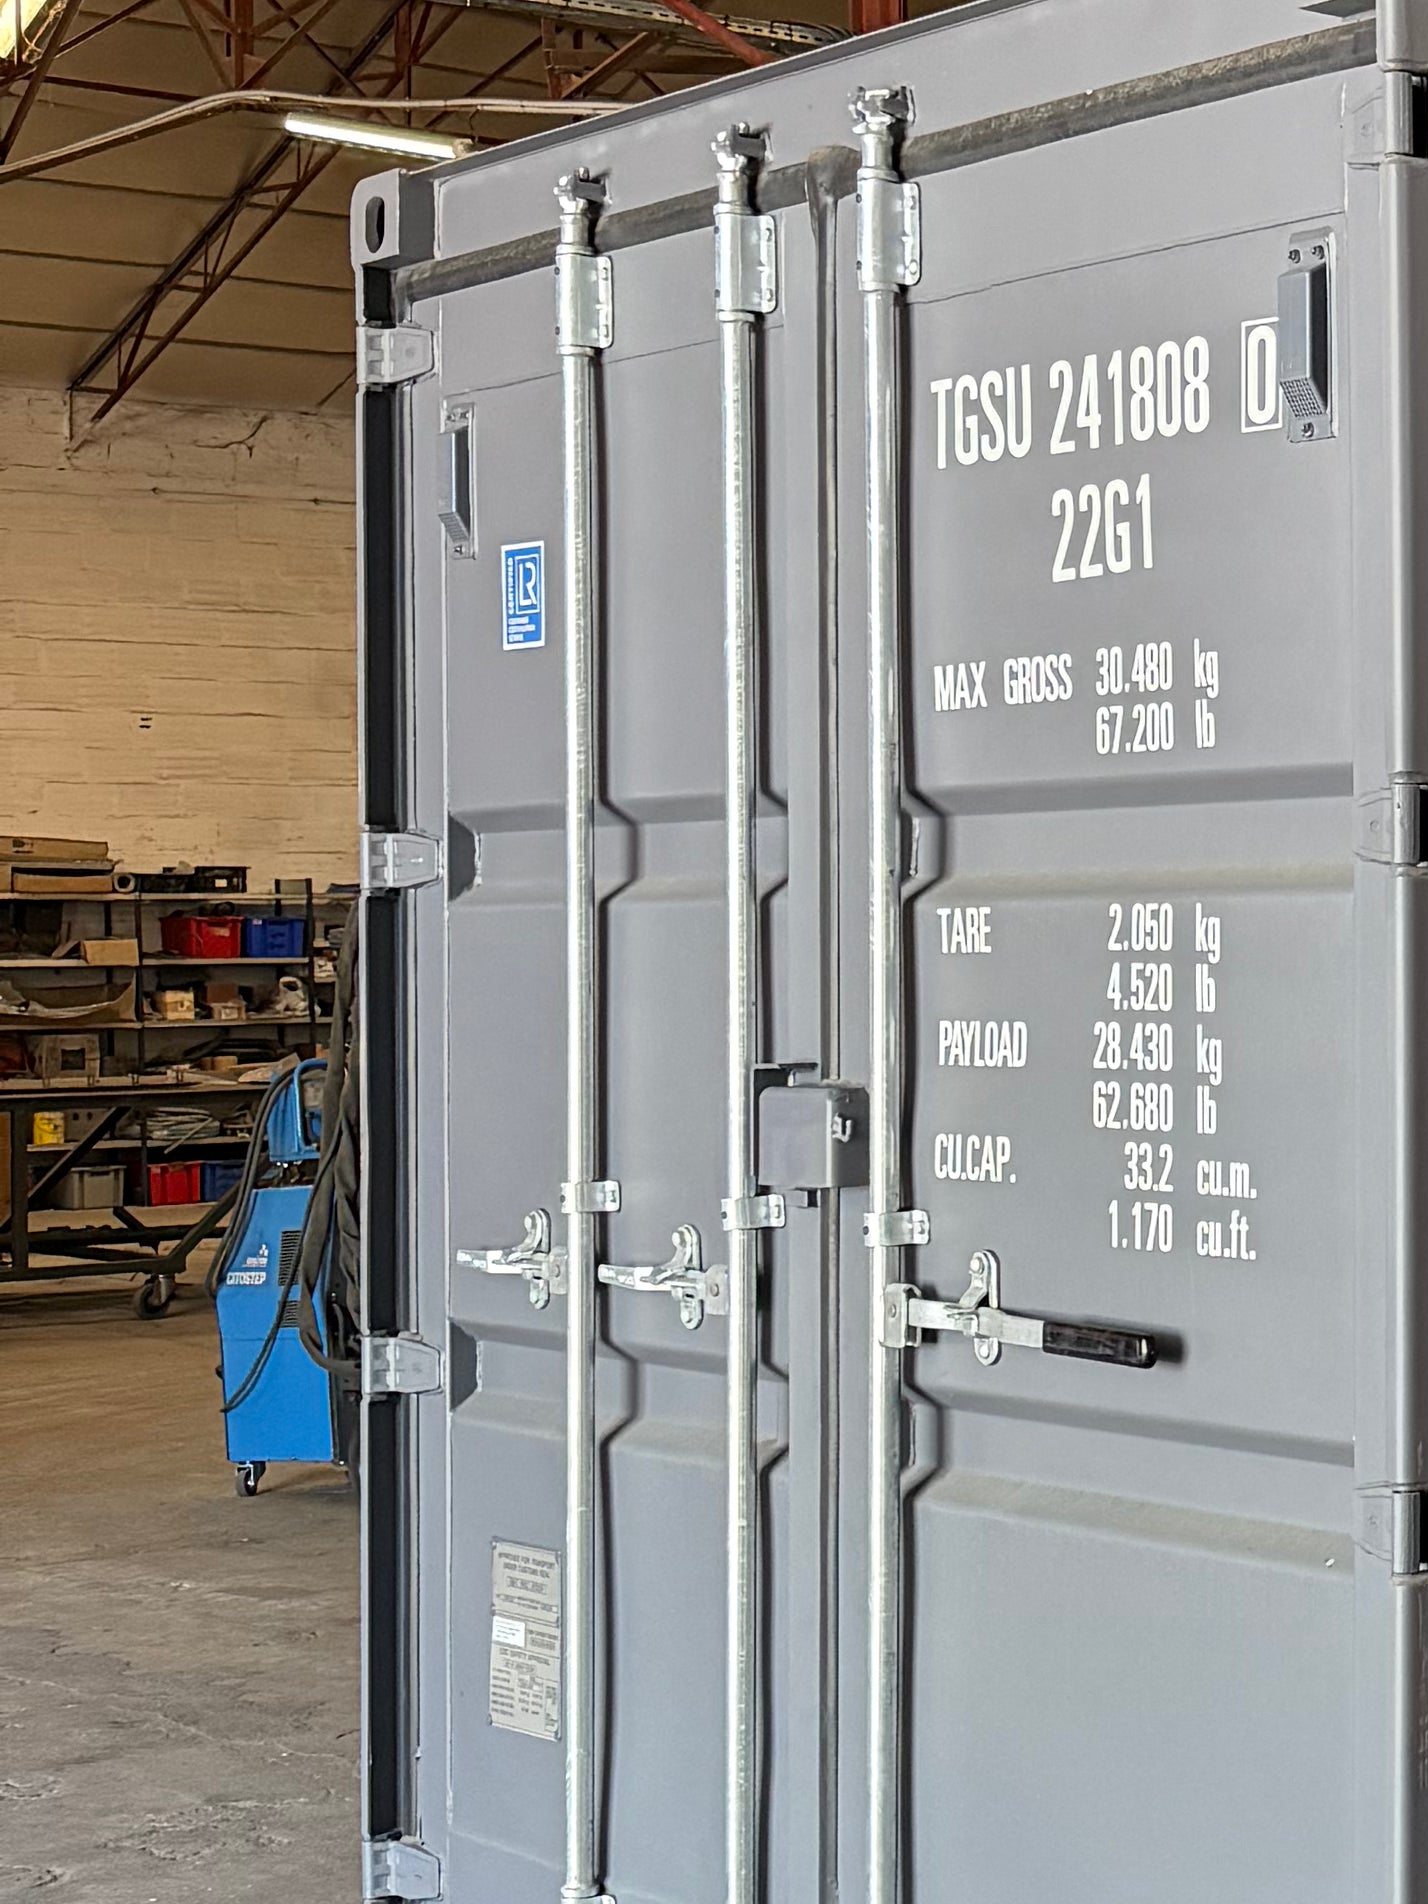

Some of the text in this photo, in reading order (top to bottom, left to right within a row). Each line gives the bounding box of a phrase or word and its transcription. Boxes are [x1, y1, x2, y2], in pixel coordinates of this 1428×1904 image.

[930, 325, 1278, 470] TGSU 241808 0
[1051, 472, 1154, 583] 22G1
[933, 637, 1219, 712] MAX GROSS 30.480 kg
[1095, 698, 1216, 755] 67.200 lb
[935, 902, 1221, 964] TARE 2.050 kg
[1106, 962, 1216, 1013] 4.520 lb
[938, 1019, 1223, 1086] PAYLOAD 28.430 kg
[1092, 1080, 1217, 1135] 62.680 lb
[934, 1133, 1258, 1199] CU.CAP. 33.2 cu.m.
[1108, 1199, 1257, 1261] 1.170 cu.ft.
